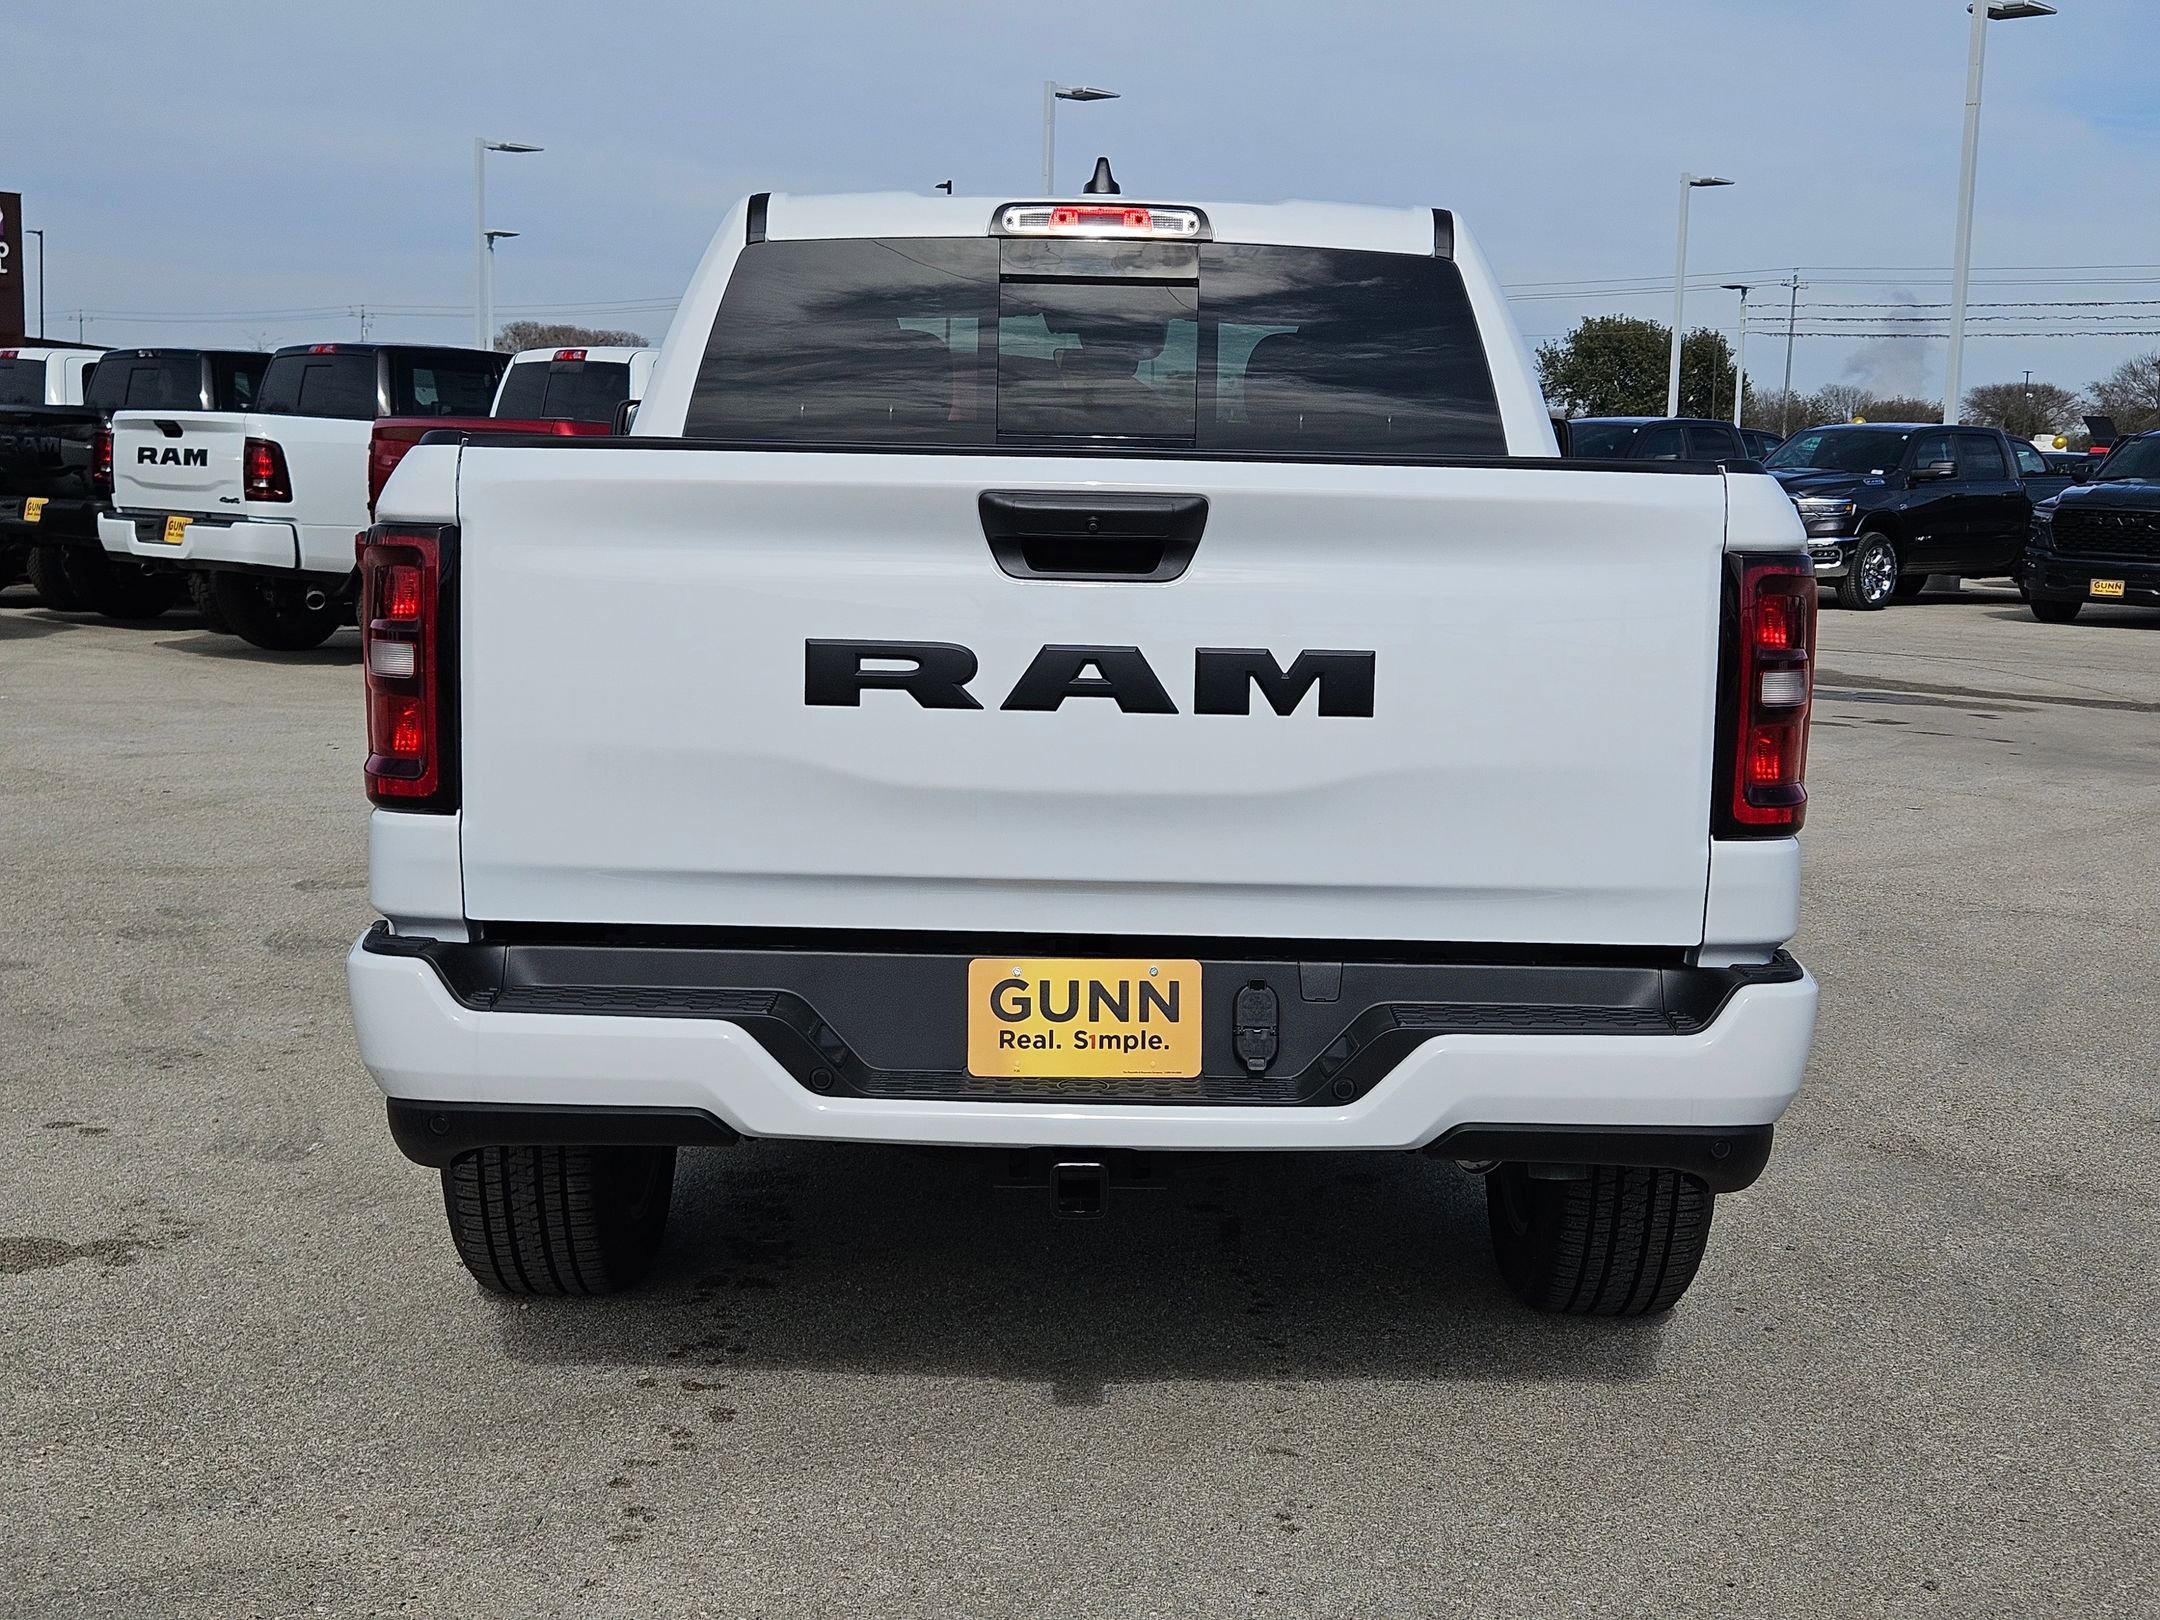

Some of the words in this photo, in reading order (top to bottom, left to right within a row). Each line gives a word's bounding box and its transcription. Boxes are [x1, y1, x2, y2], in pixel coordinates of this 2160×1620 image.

[137, 446, 208, 467] RAM
[28, 502, 41, 512] GUN
[2094, 581, 2122, 590] GUNN
[804, 637, 1376, 718] RAM
[990, 978, 1180, 1023] GUNN
[999, 1030, 1062, 1050] Real.
